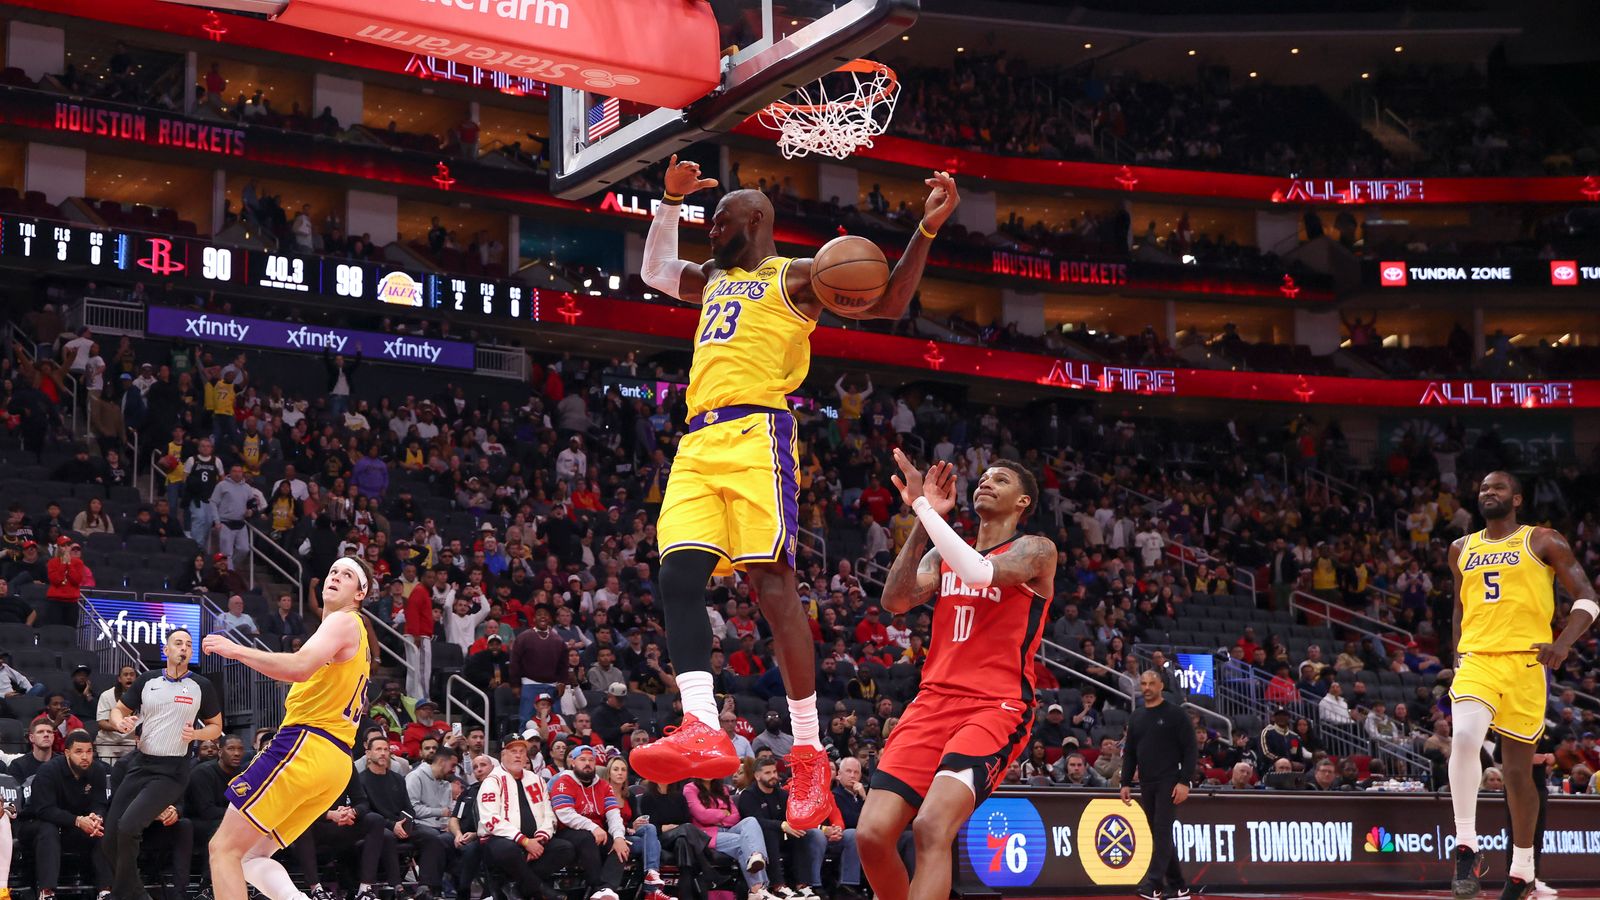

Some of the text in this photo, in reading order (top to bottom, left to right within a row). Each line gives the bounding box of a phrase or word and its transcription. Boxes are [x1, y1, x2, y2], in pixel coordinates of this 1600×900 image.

[356, 25, 581, 79] StateFarm
[55, 103, 246, 156] HOUSTON ROCKETS
[1286, 180, 1424, 201] ALL FIRE
[600, 191, 705, 224] ALL FRE
[19, 223, 36, 238] TOL
[54, 227, 71, 242] FLS
[24, 237, 31, 256] 1
[57, 241, 67, 261] 3
[203, 247, 231, 281] 90
[266, 255, 304, 284] 40.3
[993, 251, 1127, 285] HOUSTON ROCKETS
[1410, 267, 1511, 280] TUNDRA ZONE
[1580, 266, 1600, 279] TU
[336, 264, 363, 297] 98
[452, 279, 467, 293] TOL
[480, 283, 495, 297] FLS
[705, 279, 770, 305] LAKERS
[455, 292, 464, 310] 2
[483, 296, 492, 314] 5
[186, 315, 249, 341] xfinity
[700, 301, 742, 344] 23
[287, 326, 348, 351] xfinity
[383, 337, 442, 362] xfinity
[1048, 360, 1175, 392] ALL FIRE
[1420, 382, 1573, 404] ALL FIRE
[201, 471, 209, 482] 6
[1464, 551, 1520, 571] LAKERS
[1483, 571, 1501, 601] 5
[97, 610, 188, 648] xfinit
[952, 605, 975, 642] 10
[1174, 664, 1206, 693] nity
[482, 793, 495, 803] 22
[526, 783, 543, 804] H
[485, 816, 500, 831] 34
[1052, 826, 1072, 857] VS
[1215, 824, 1236, 863] ET
[1246, 820, 1353, 863] TOMORROW
[1395, 829, 1508, 859] NBC pcock
[1556, 830, 1586, 853] LOCAL
